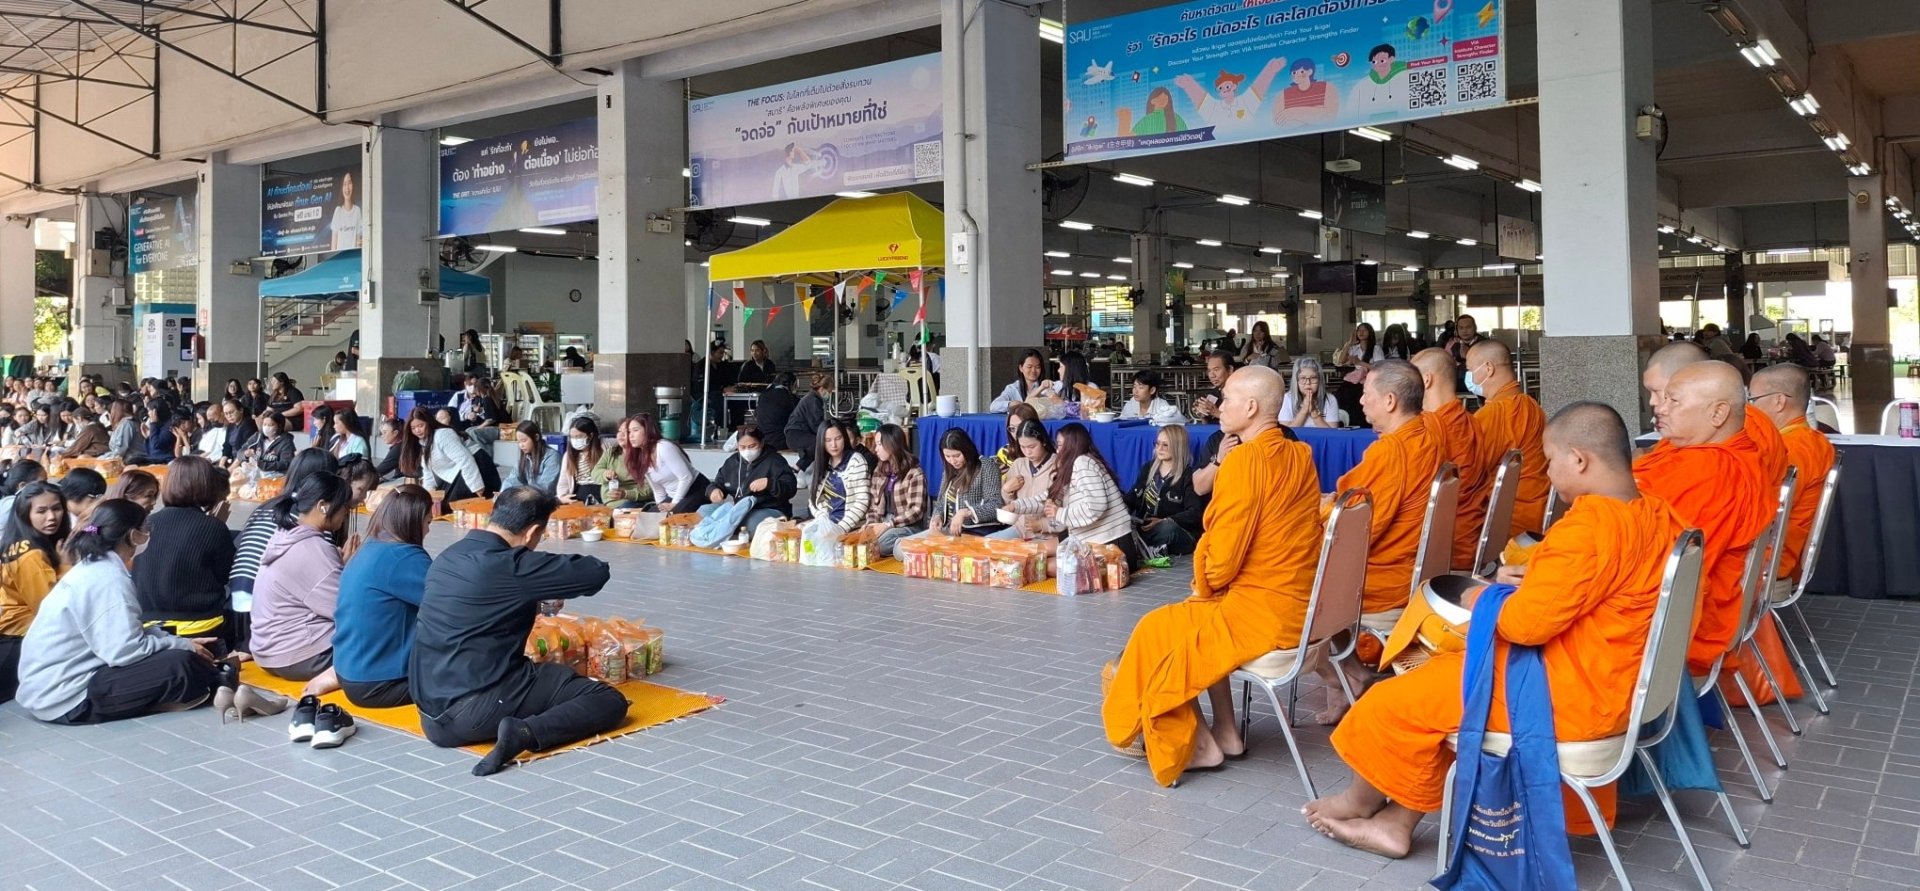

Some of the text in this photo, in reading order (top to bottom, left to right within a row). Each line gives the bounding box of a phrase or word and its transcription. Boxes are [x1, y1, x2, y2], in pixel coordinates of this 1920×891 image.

[1202, 14, 1260, 38] ถนัดอะไร
[1284, 29, 1297, 37] Find
[1069, 28, 1091, 44] SAU
[1167, 57, 1190, 67] Discover
[1191, 54, 1204, 63] Your
[1205, 50, 1229, 61] Strength
[1253, 42, 1277, 51] Institute
[1278, 36, 1307, 46] Character
[1308, 31, 1338, 41] Strengths
[1339, 26, 1359, 35] Finder
[747, 97, 760, 108] THE
[761, 93, 785, 105] FOCUS:
[787, 98, 888, 135] กับเป้าหมายที่ใช่
[452, 168, 470, 183] ต้อง
[310, 194, 323, 204] Gen
[324, 191, 332, 202] AI
[133, 239, 164, 254] GENERATIVE
[142, 250, 169, 264] EVERYONE
